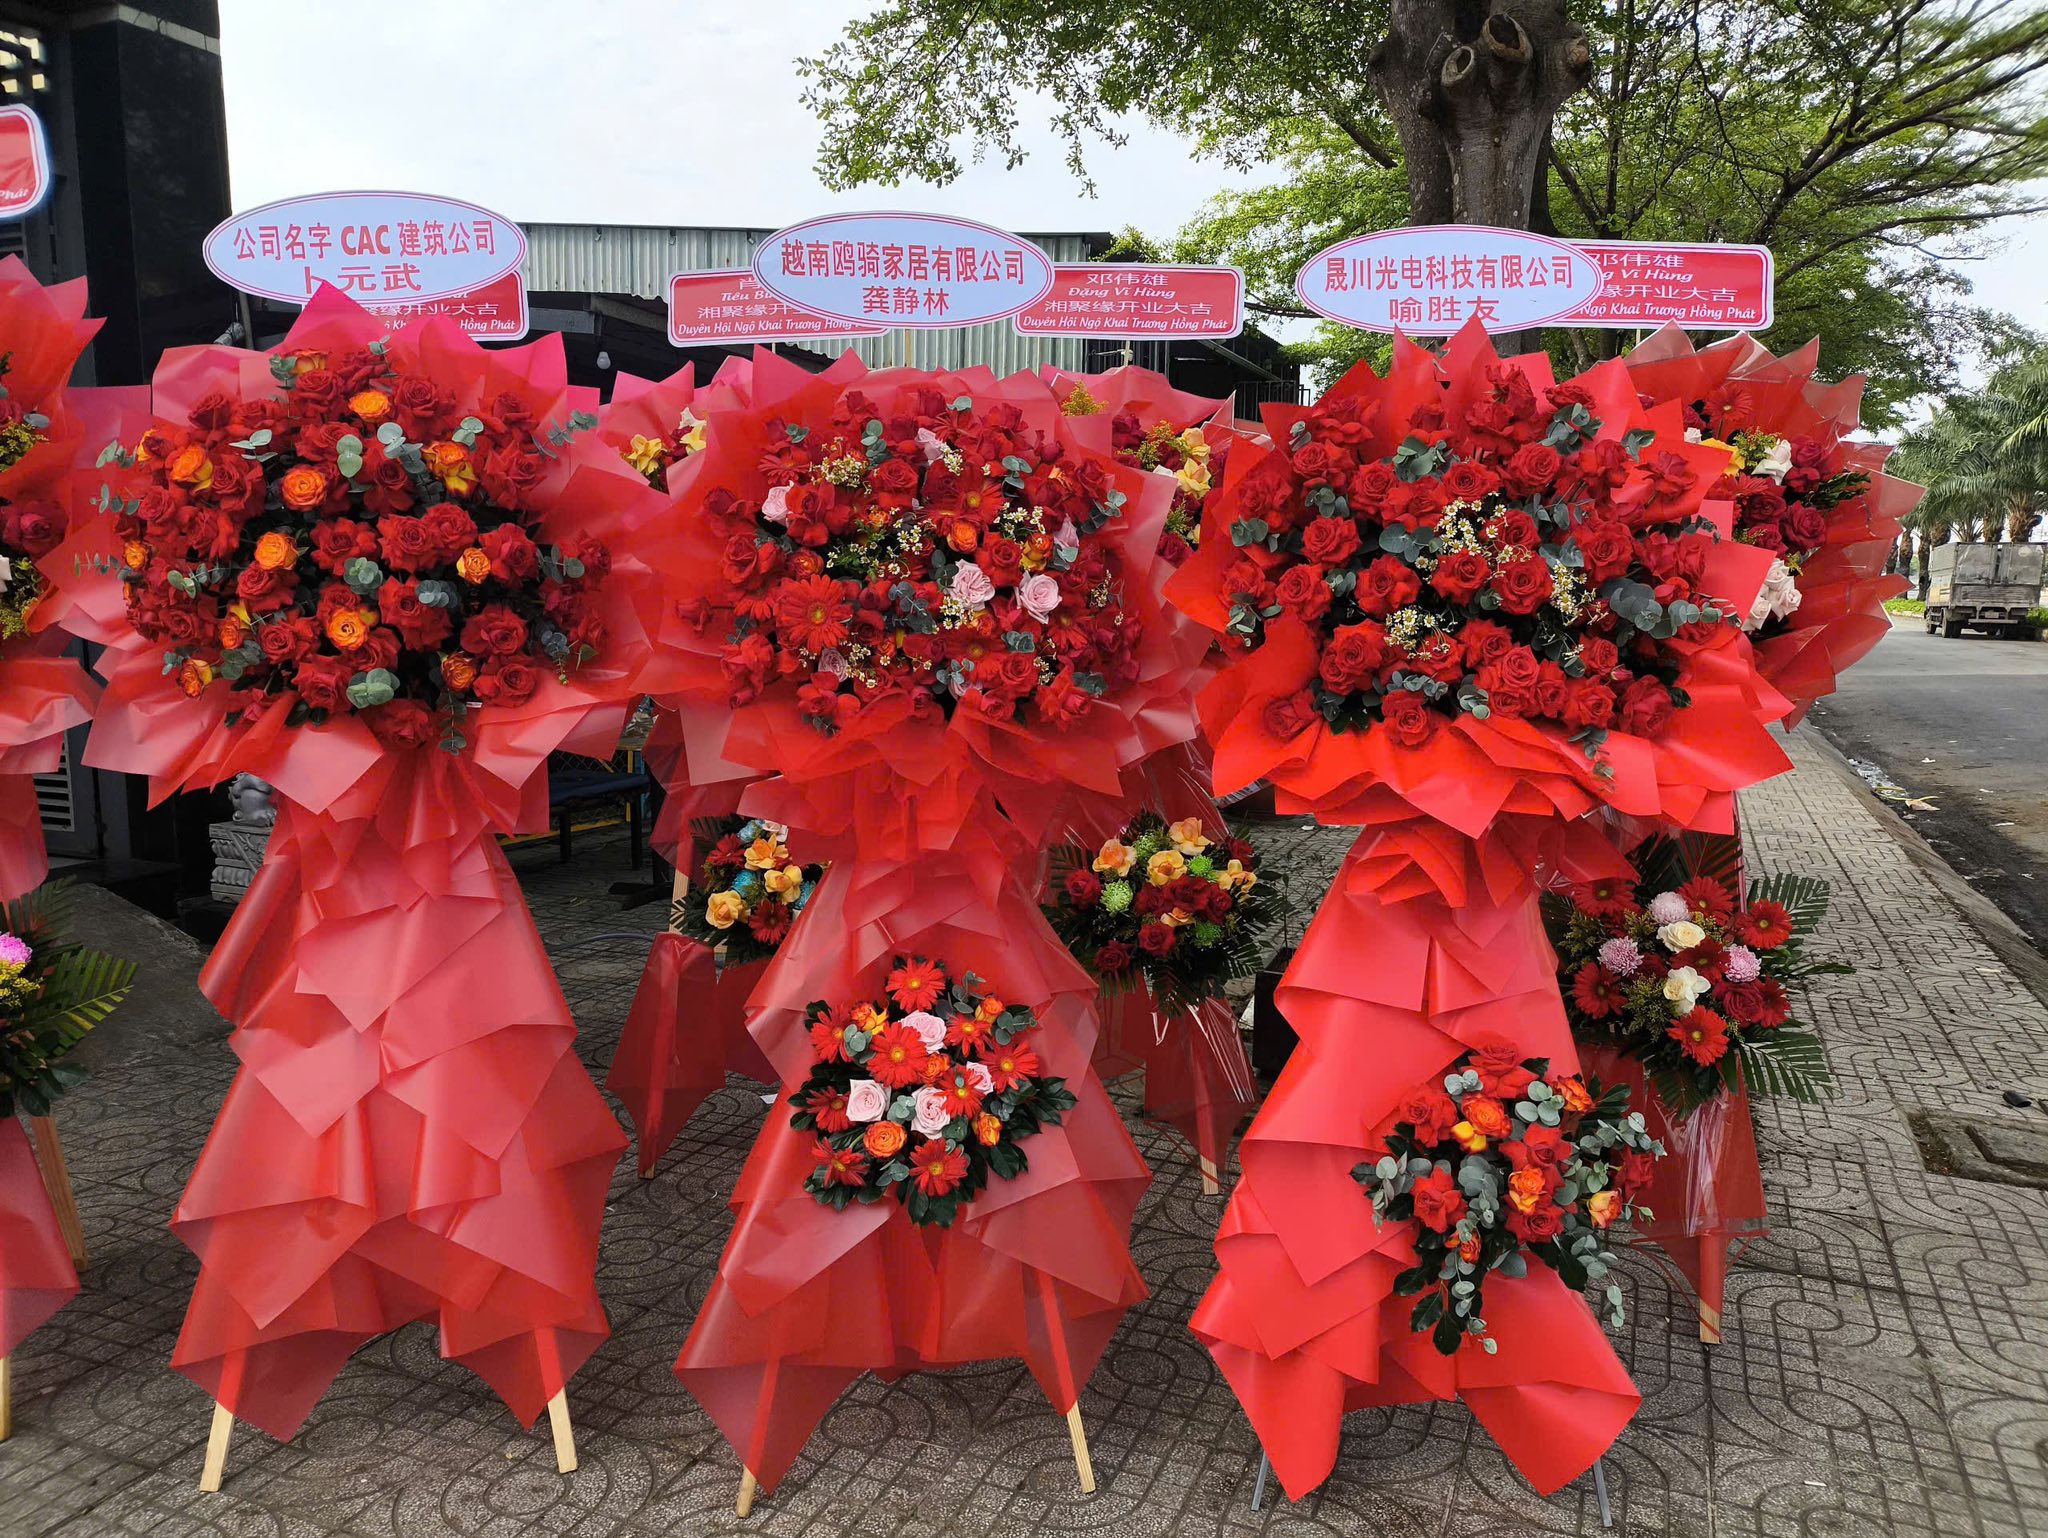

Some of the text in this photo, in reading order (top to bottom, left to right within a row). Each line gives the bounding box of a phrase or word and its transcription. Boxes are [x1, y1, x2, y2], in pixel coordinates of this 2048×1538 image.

[233, 219, 496, 261] 公司名字 CAC 建筑公司
[781, 238, 1025, 285] 越南鸥骑家居有限公司
[1086, 272, 1169, 286] 邓伟雄
[1324, 254, 1573, 293] 晟川光电科技有限公司
[1644, 269, 1693, 283] Hùng
[862, 286, 950, 316] 龚静林
[1068, 287, 1110, 298] Đặng
[1133, 287, 1176, 300] Hùng
[697, 303, 808, 319] 湘聚缘开
[1044, 300, 1213, 316] 湘聚缘开业大吉
[1389, 296, 1500, 323] 喻胜友
[1580, 302, 1756, 320] Ngộ Khai Trương Hồng Phát
[460, 317, 487, 332] Hồng
[490, 319, 516, 330] Phát
[678, 323, 711, 337] Duyên
[714, 321, 732, 335] Hội
[734, 320, 756, 334] Ngộ
[758, 319, 783, 331] Khai
[786, 318, 821, 331] Trương
[1023, 316, 1228, 332] Duyên Hội Ngộ Khai Trương Hồng Phát
